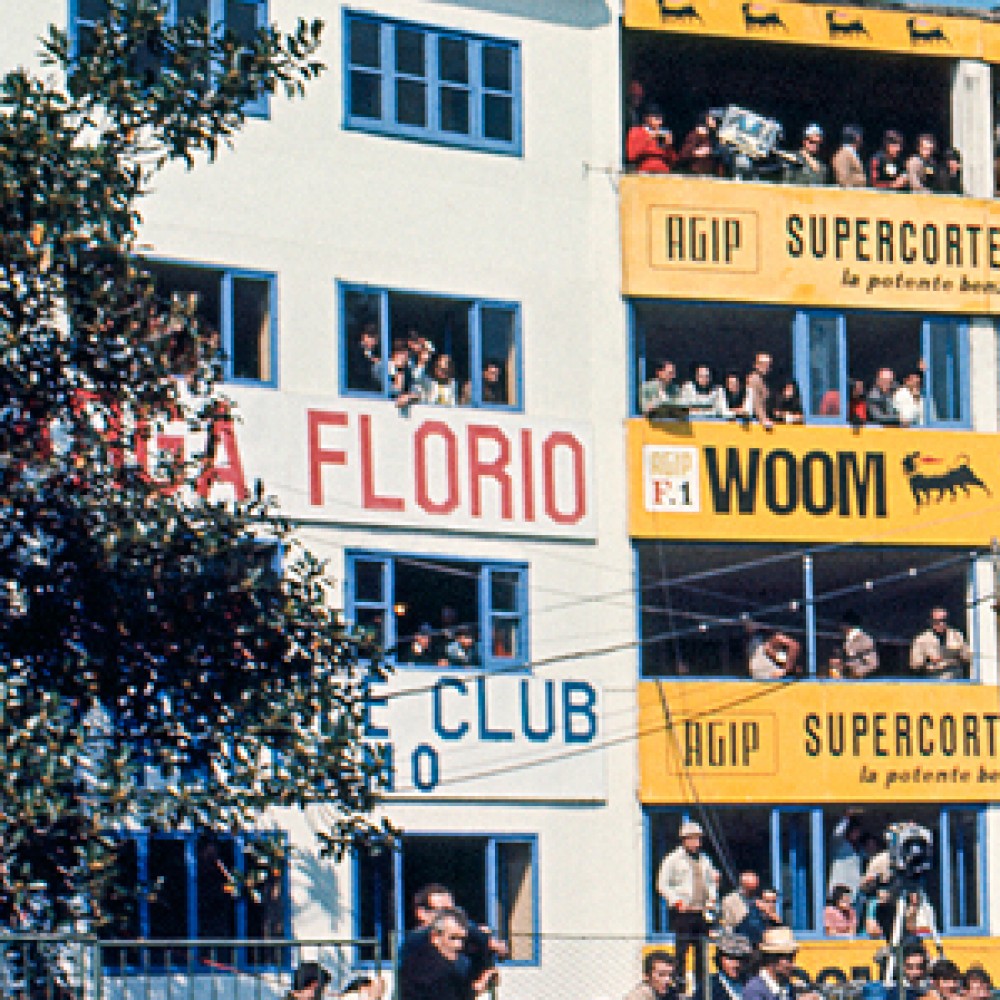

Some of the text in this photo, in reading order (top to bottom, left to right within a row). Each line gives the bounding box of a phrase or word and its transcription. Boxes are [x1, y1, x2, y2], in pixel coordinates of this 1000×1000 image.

[665, 214, 743, 264] AGIP
[307, 408, 586, 525] FLORIO
[702, 445, 889, 518] WOOM
[431, 675, 598, 744] CLUB
[682, 717, 760, 767] AGIP
